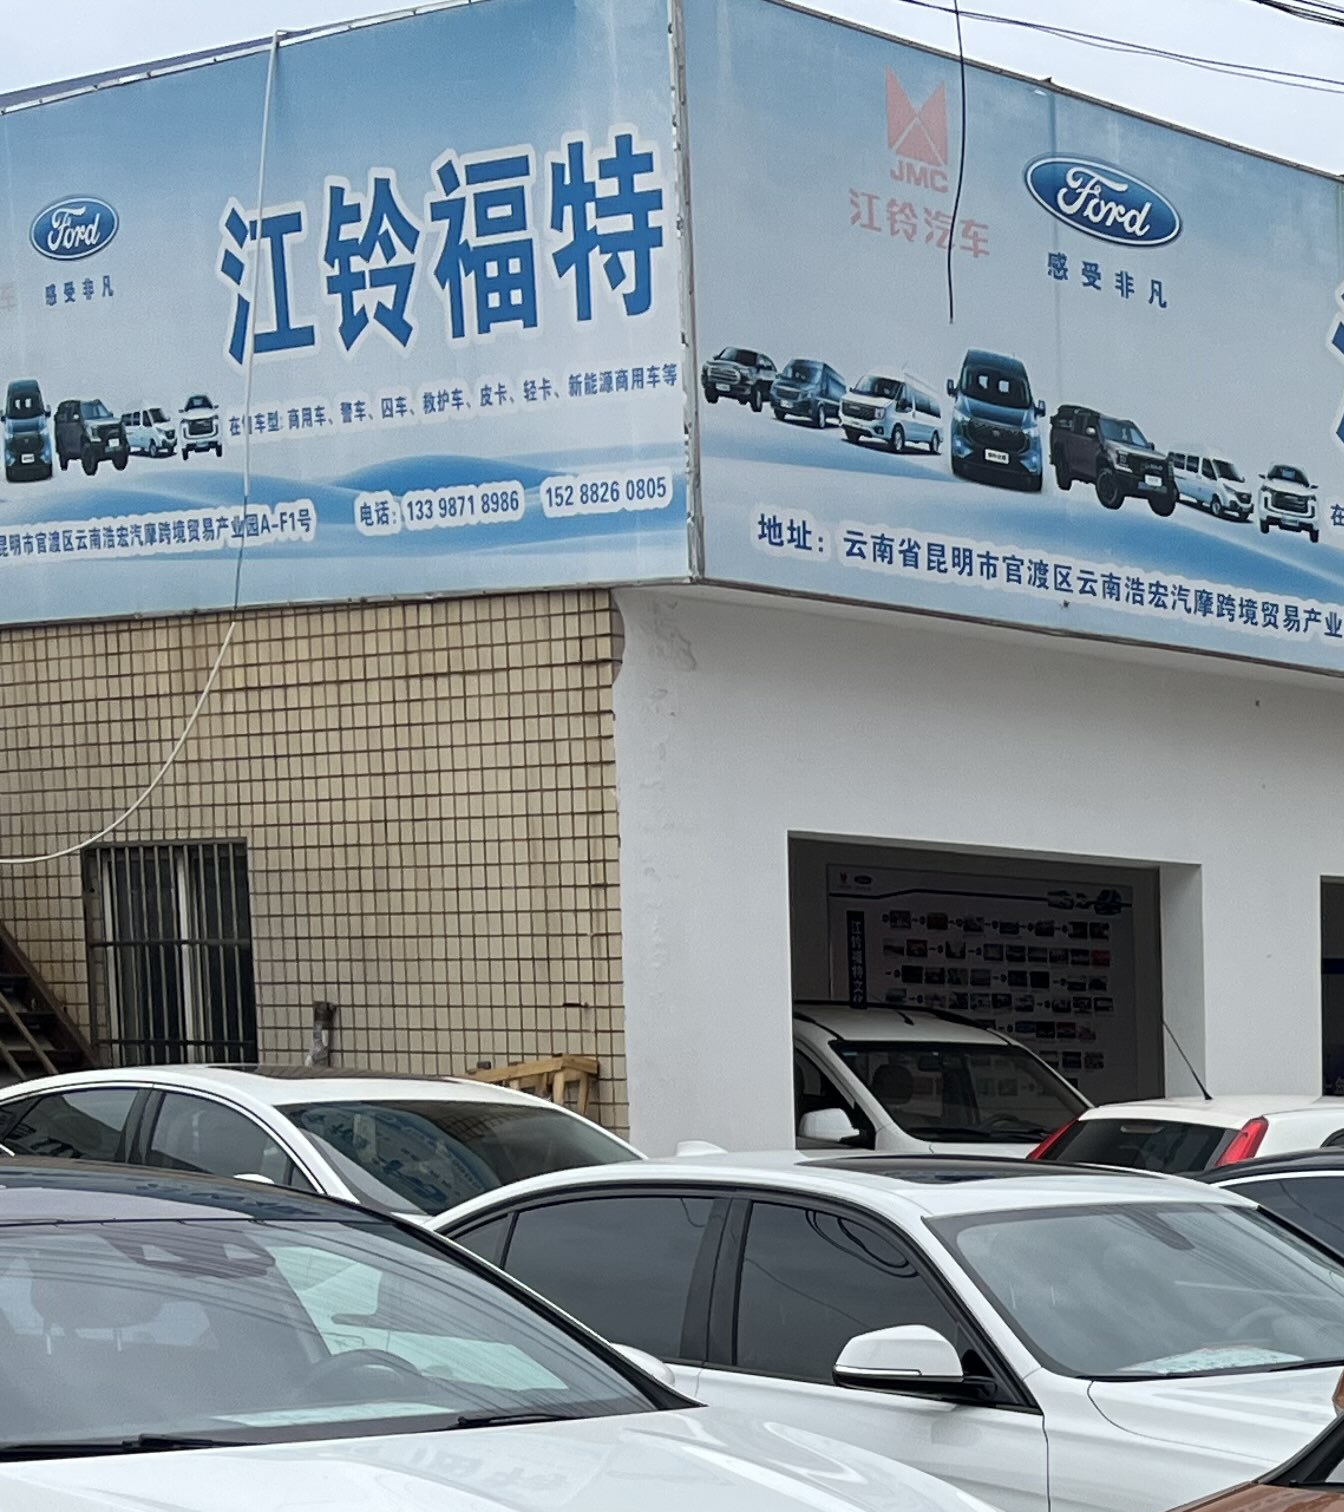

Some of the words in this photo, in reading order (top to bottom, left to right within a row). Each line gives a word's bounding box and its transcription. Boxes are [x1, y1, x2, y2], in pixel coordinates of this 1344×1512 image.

[889, 160, 949, 194] JMC
[1056, 166, 1152, 237] Ford
[46, 203, 102, 252] Ford
[222, 132, 664, 366] 江铃福特
[849, 187, 991, 259] 江铃汽车
[44, 274, 115, 306] 感受非凡
[1047, 251, 1168, 309] 感受非凡
[406, 499, 433, 521] 133
[438, 495, 475, 519] 9871
[480, 490, 519, 514] 8986
[545, 485, 574, 507] 152
[580, 480, 620, 505] 8826
[625, 476, 667, 501] 0805
